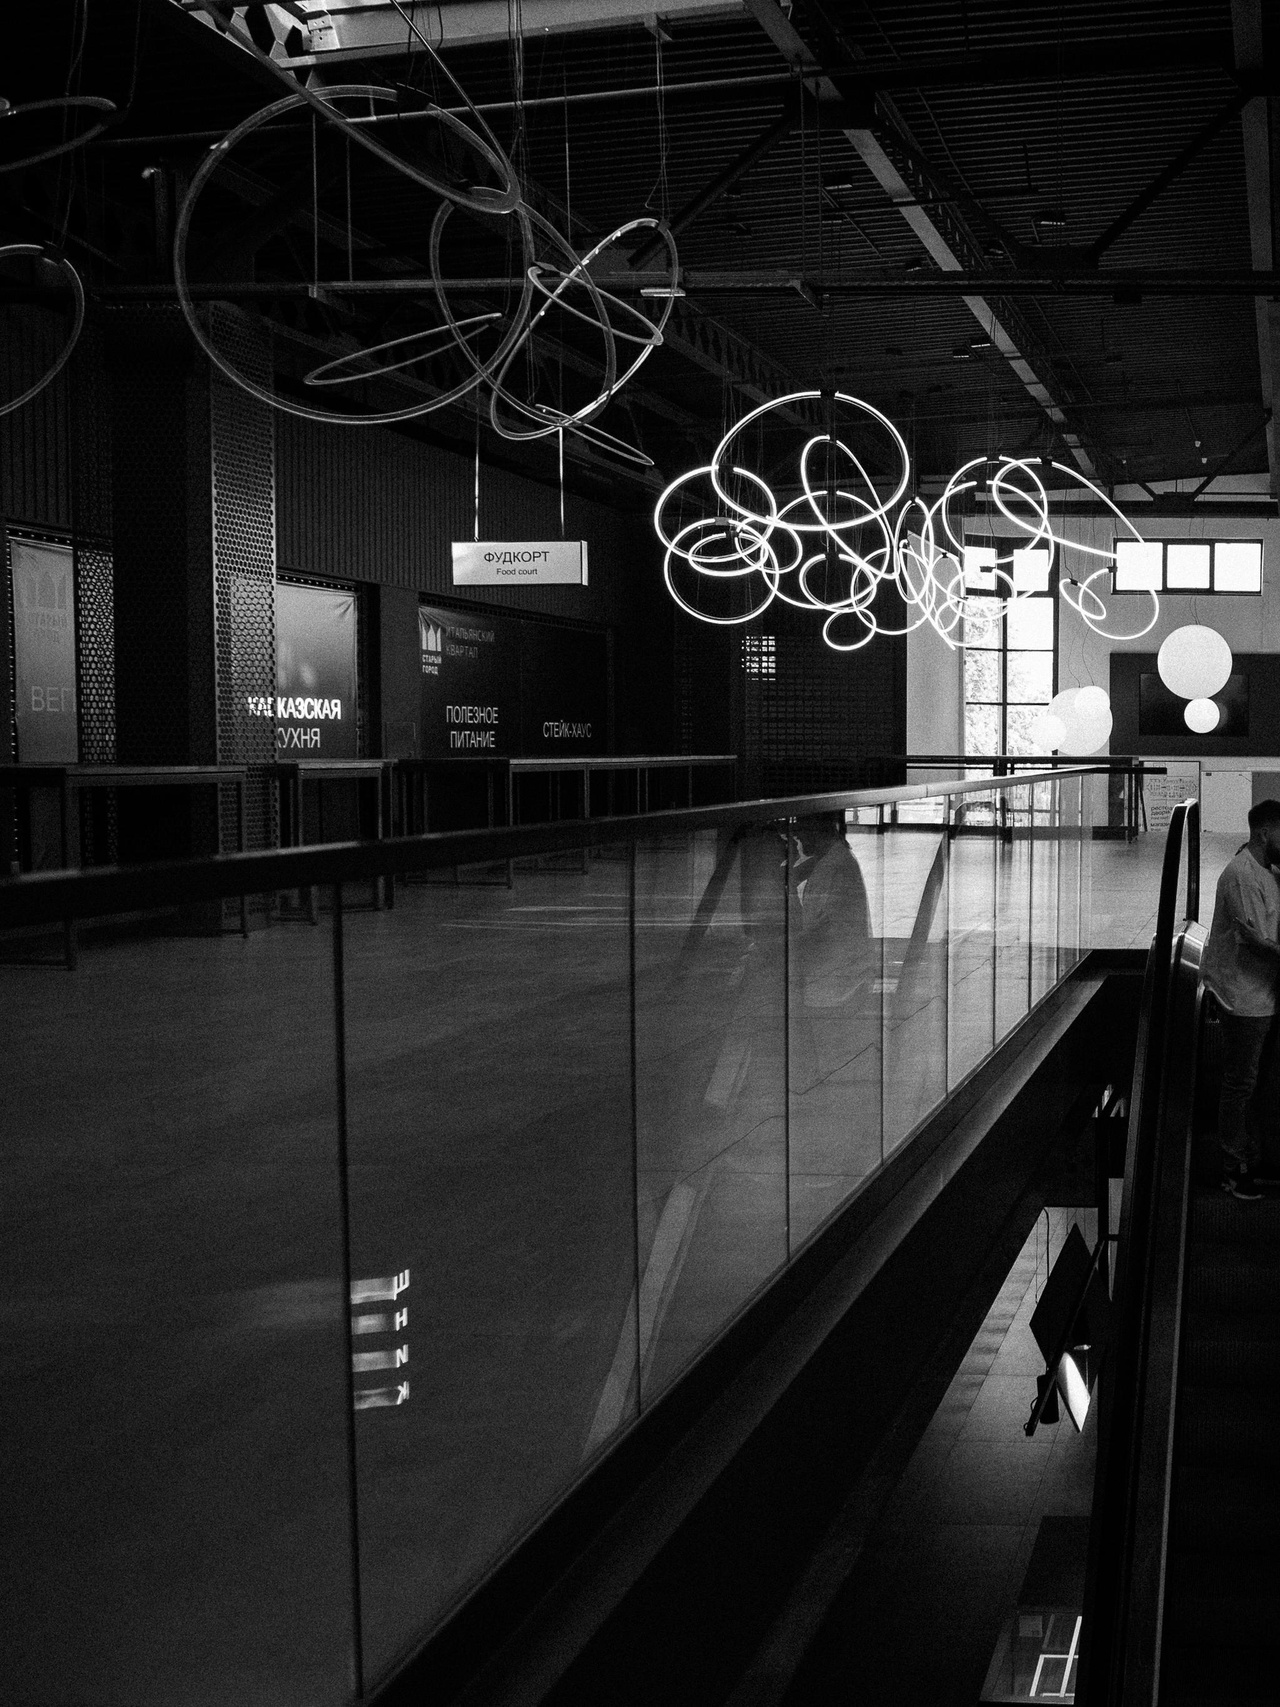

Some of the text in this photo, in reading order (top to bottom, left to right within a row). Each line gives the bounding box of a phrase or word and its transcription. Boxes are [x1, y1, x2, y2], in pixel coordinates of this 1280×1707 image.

[484, 551, 550, 565] ФУДКОРТ
[31, 685, 77, 712] ВЕГ
[446, 705, 499, 724] ПОЛЕЗНОЕ
[278, 727, 320, 748] УХНЯ
[543, 719, 592, 738] СТЕЙК-ХАУС
[450, 731, 496, 748] ПИТАНИЕ
